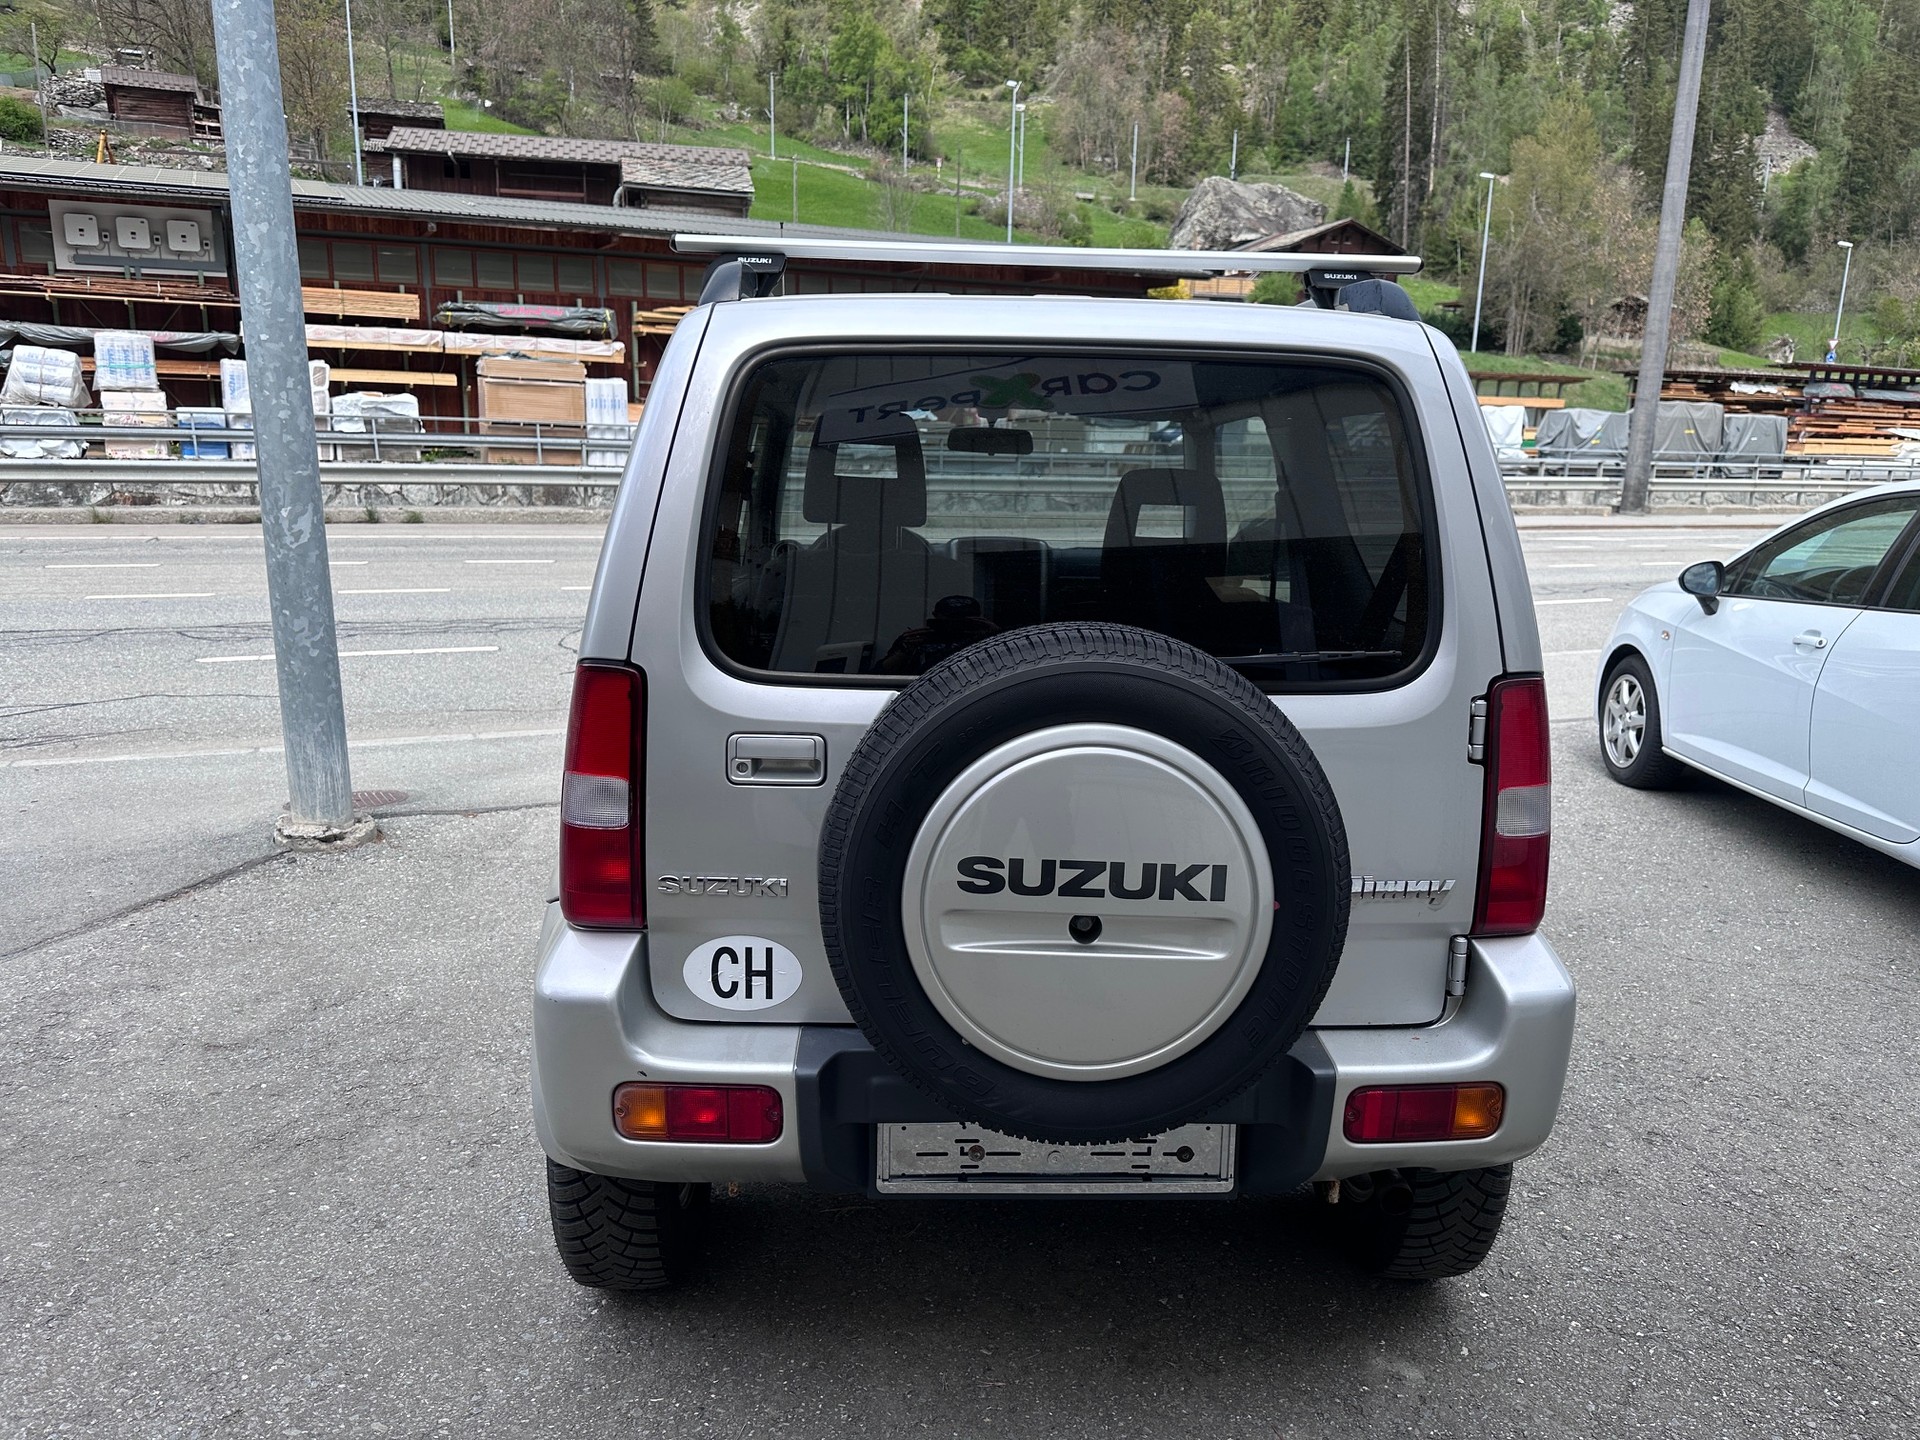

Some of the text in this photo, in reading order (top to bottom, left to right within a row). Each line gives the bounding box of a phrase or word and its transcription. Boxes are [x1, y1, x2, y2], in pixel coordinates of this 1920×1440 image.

[657, 875, 789, 897] SUZUKI
[957, 856, 1228, 902] SUZUKI
[1208, 728, 1315, 1050] BRIDGESTONE
[711, 946, 773, 999] CH
[860, 873, 1000, 1097] DUELER
